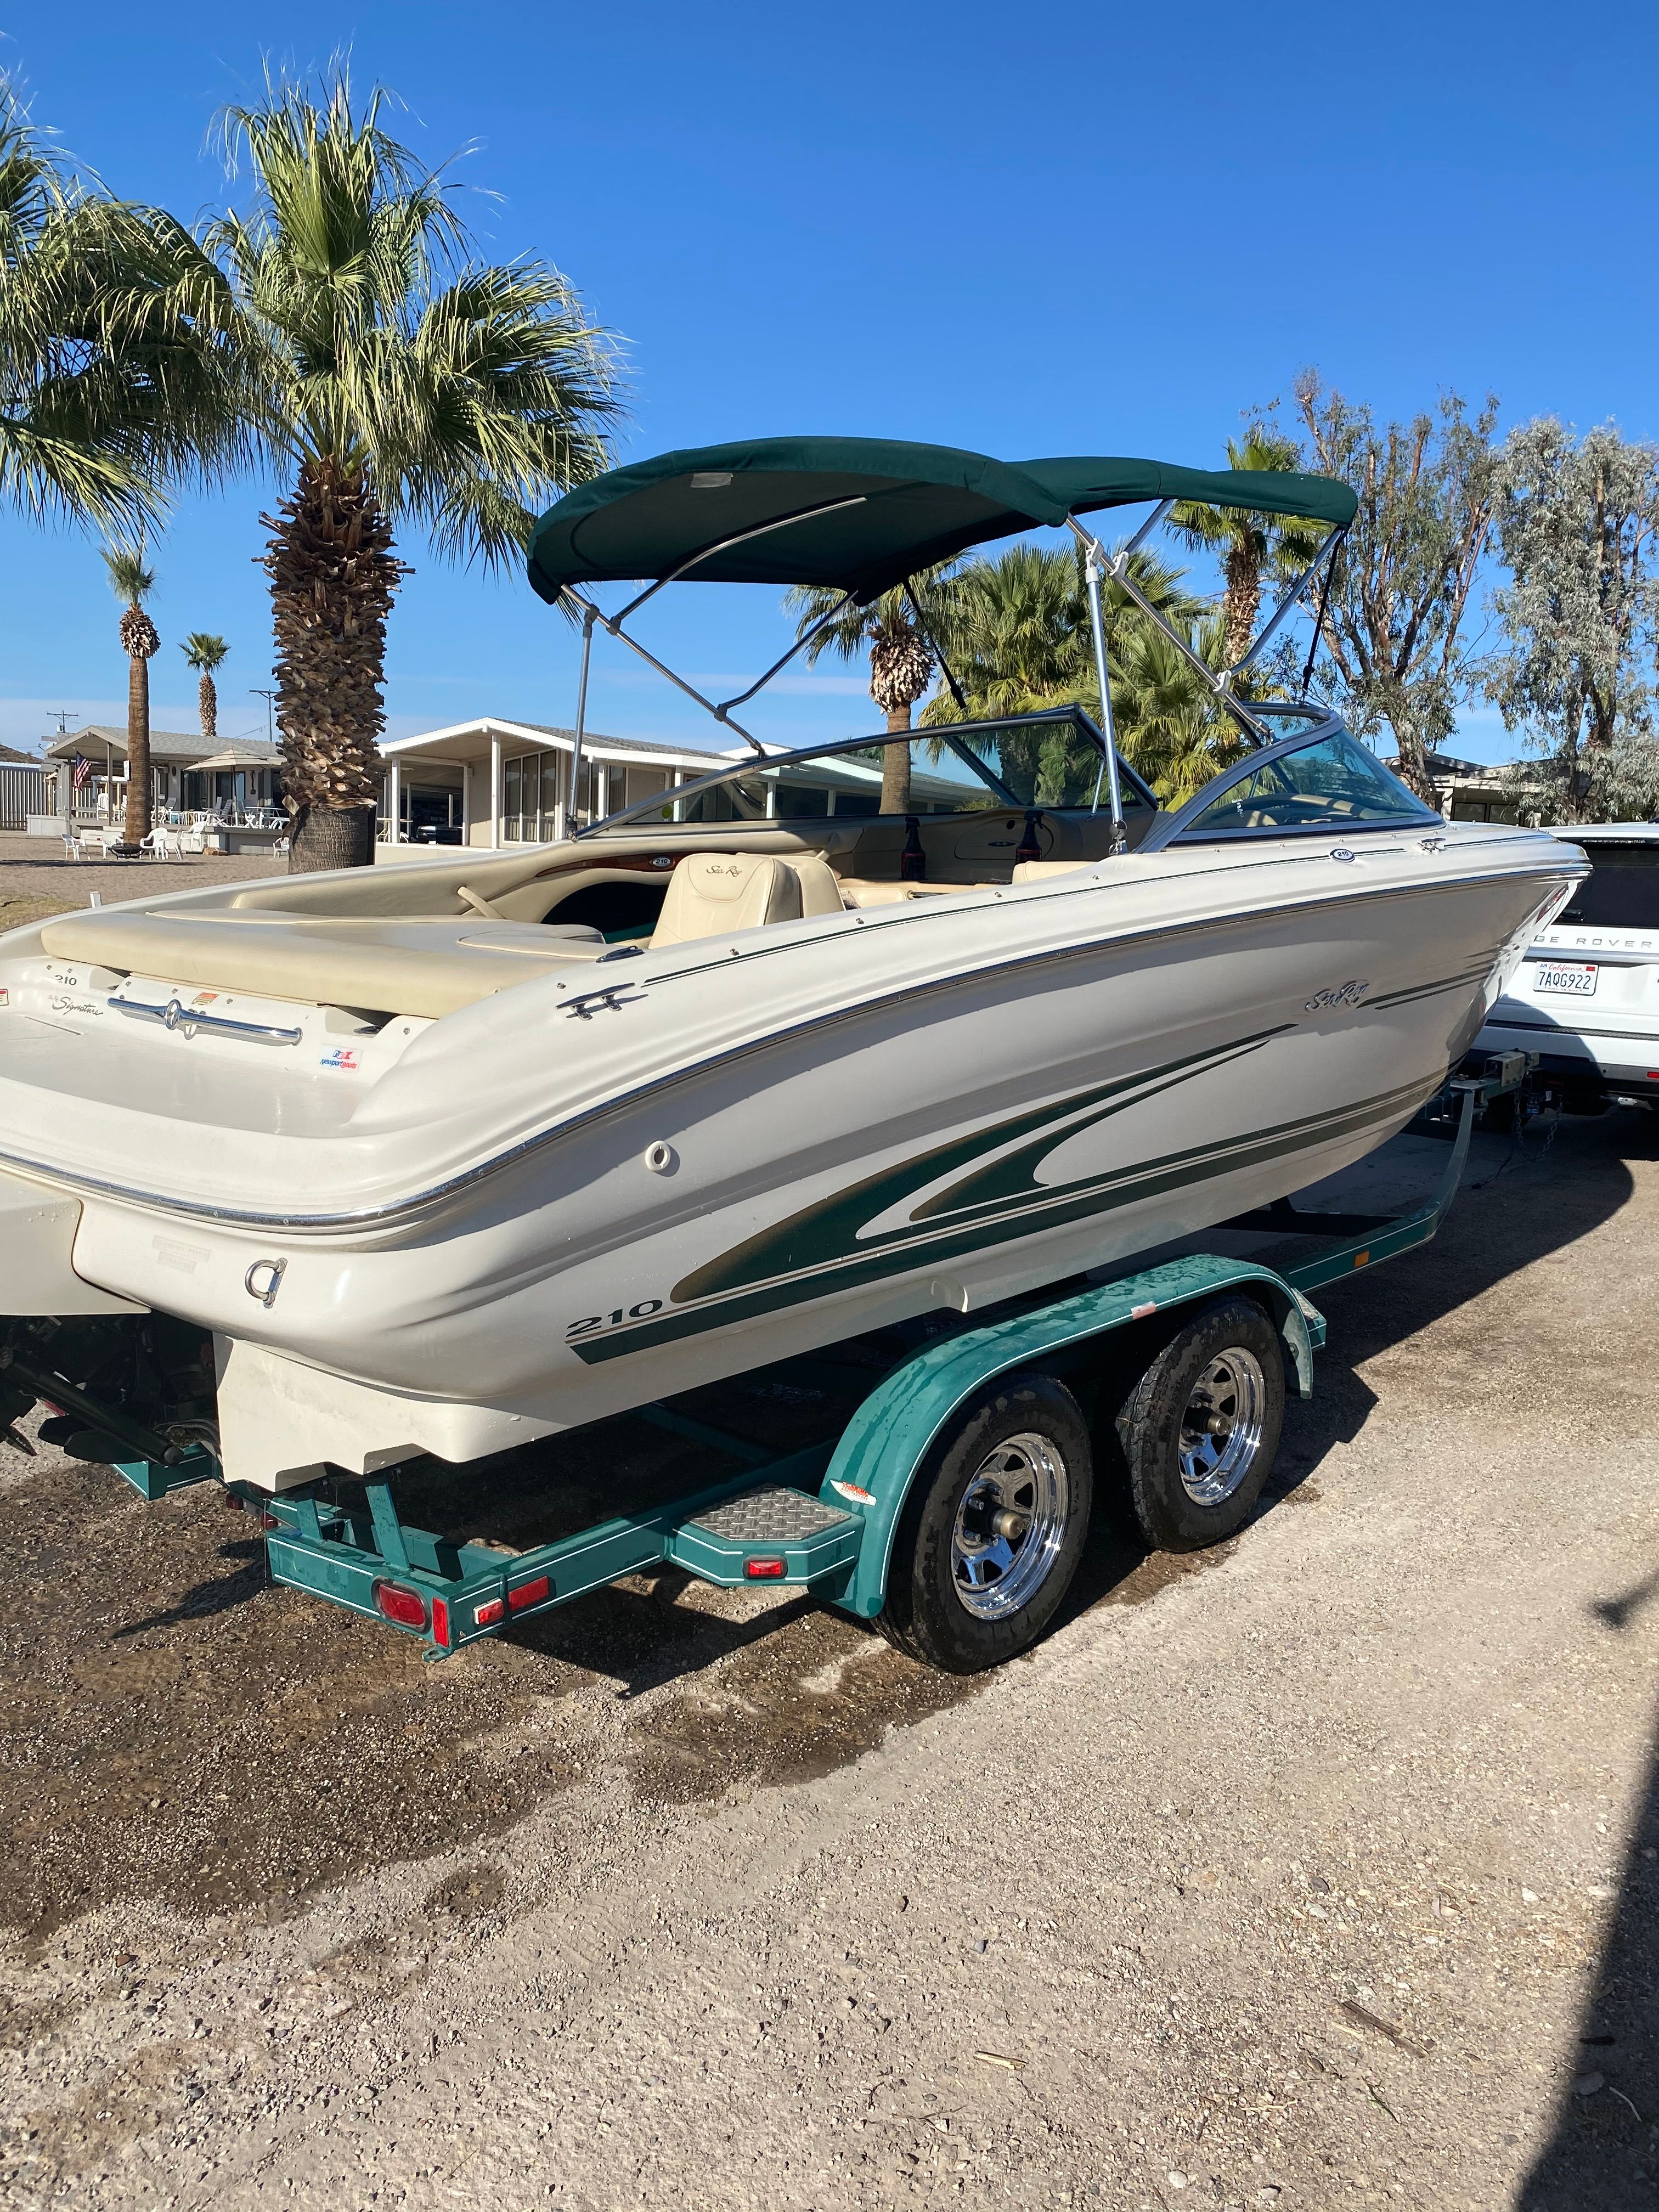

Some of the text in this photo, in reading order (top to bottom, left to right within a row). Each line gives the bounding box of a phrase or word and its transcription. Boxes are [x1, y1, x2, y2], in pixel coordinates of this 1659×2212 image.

[706, 865, 742, 877] Sea Ray
[1576, 938, 1652, 948] ROVER
[1548, 963, 1585, 973] California
[55, 975, 77, 985] 210
[1539, 972, 1591, 990] 7AQG922
[52, 997, 103, 1015] Signature
[566, 1300, 663, 1337] 210
